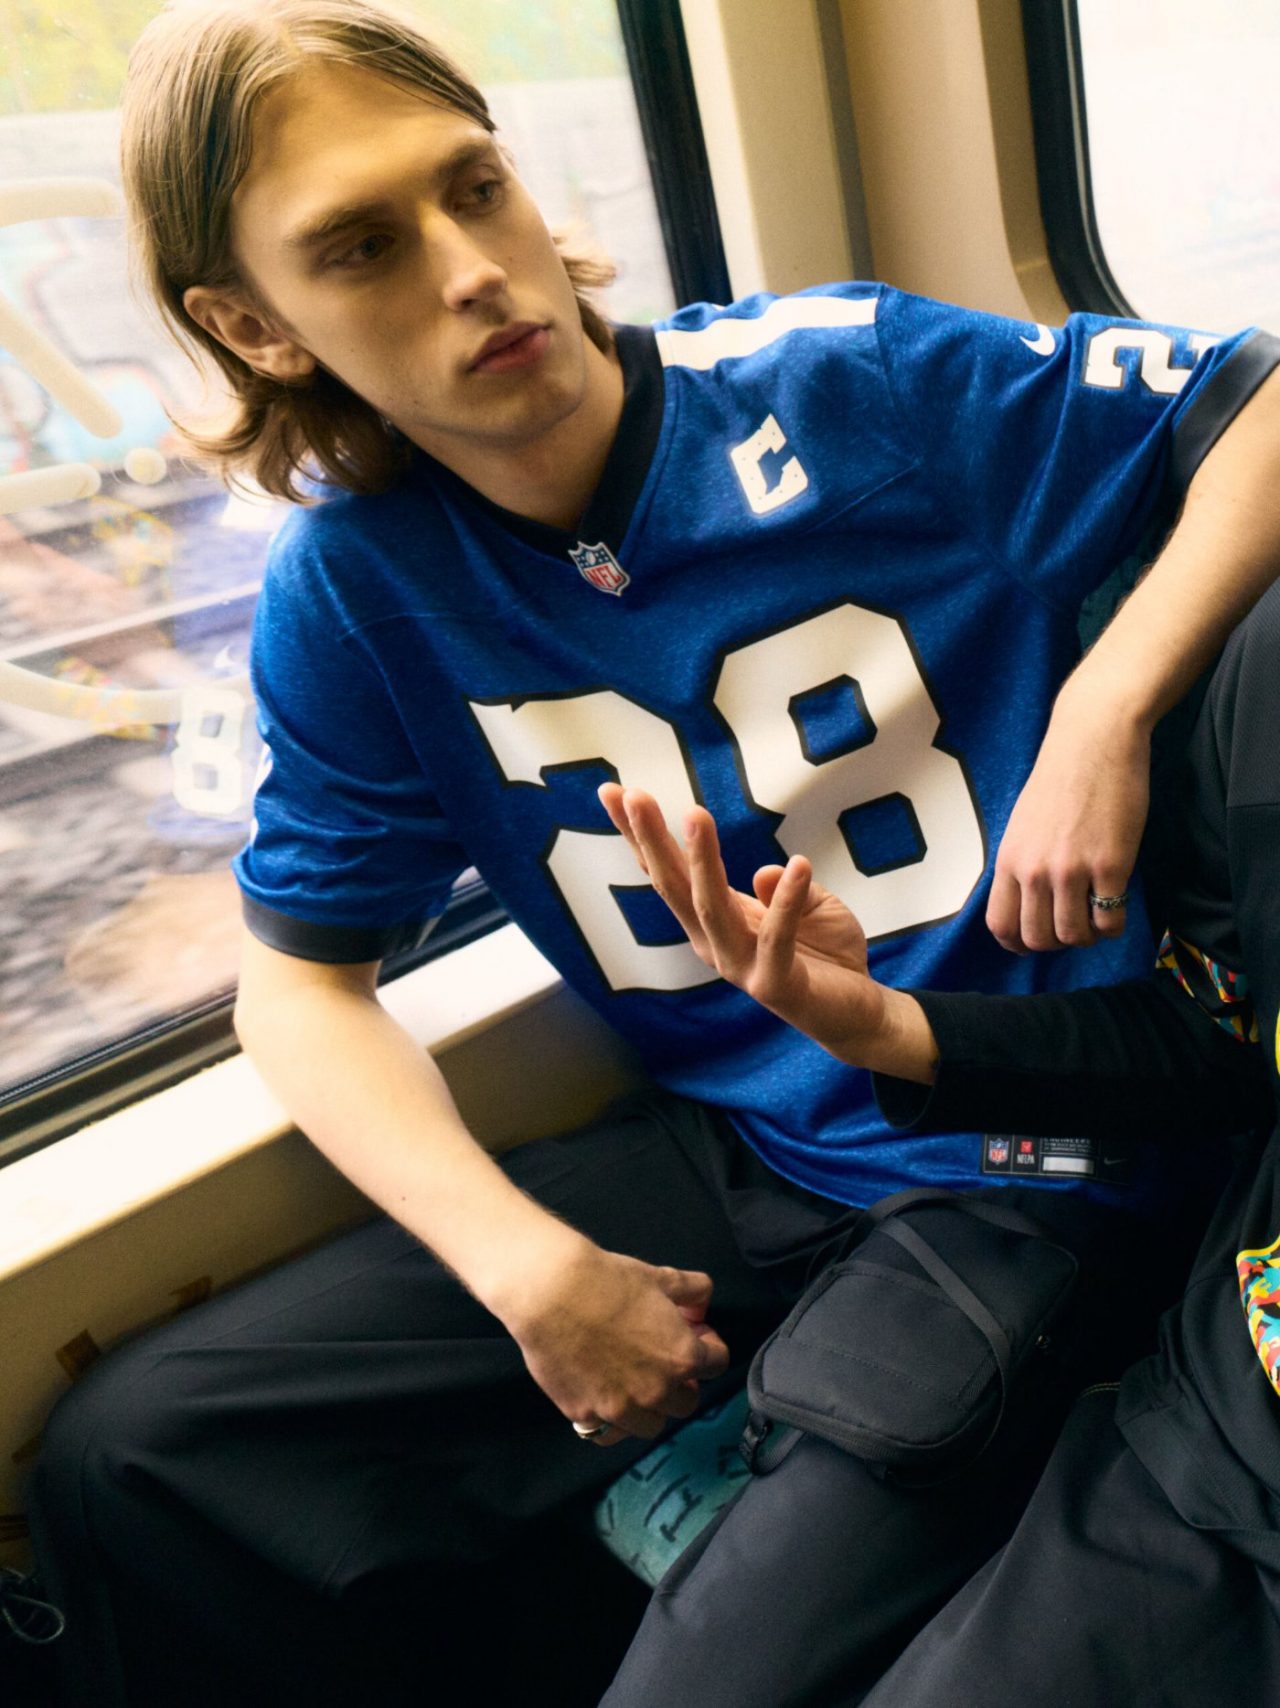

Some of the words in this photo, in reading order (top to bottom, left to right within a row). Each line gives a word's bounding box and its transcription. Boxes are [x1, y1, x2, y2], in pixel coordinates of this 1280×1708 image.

[729, 413, 809, 515] C
[584, 564, 622, 590] NFL
[467, 601, 988, 991] 28
